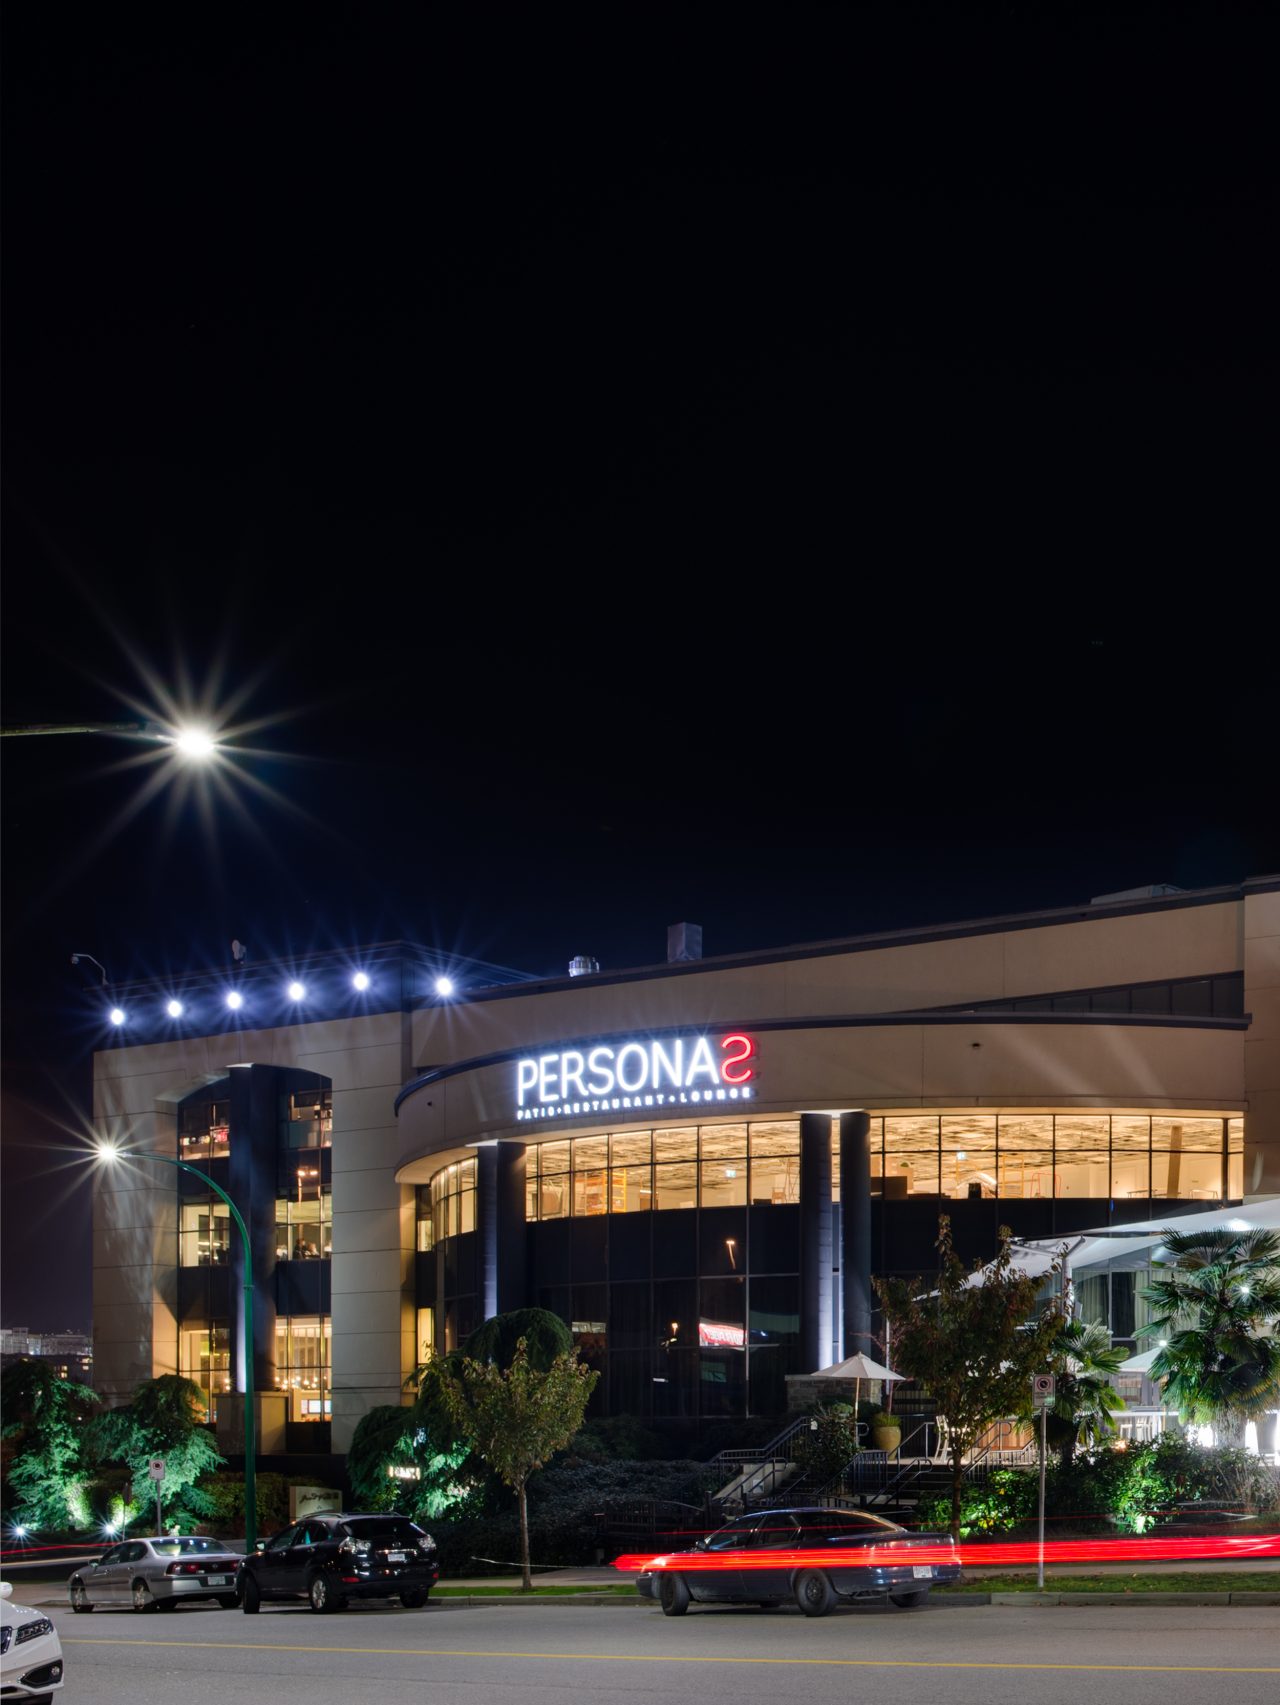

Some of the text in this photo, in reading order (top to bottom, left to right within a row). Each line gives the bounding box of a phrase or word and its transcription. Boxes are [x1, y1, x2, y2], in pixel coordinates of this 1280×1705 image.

[517, 1086, 750, 1120] PATIO RESTAURANT LOUNGE
